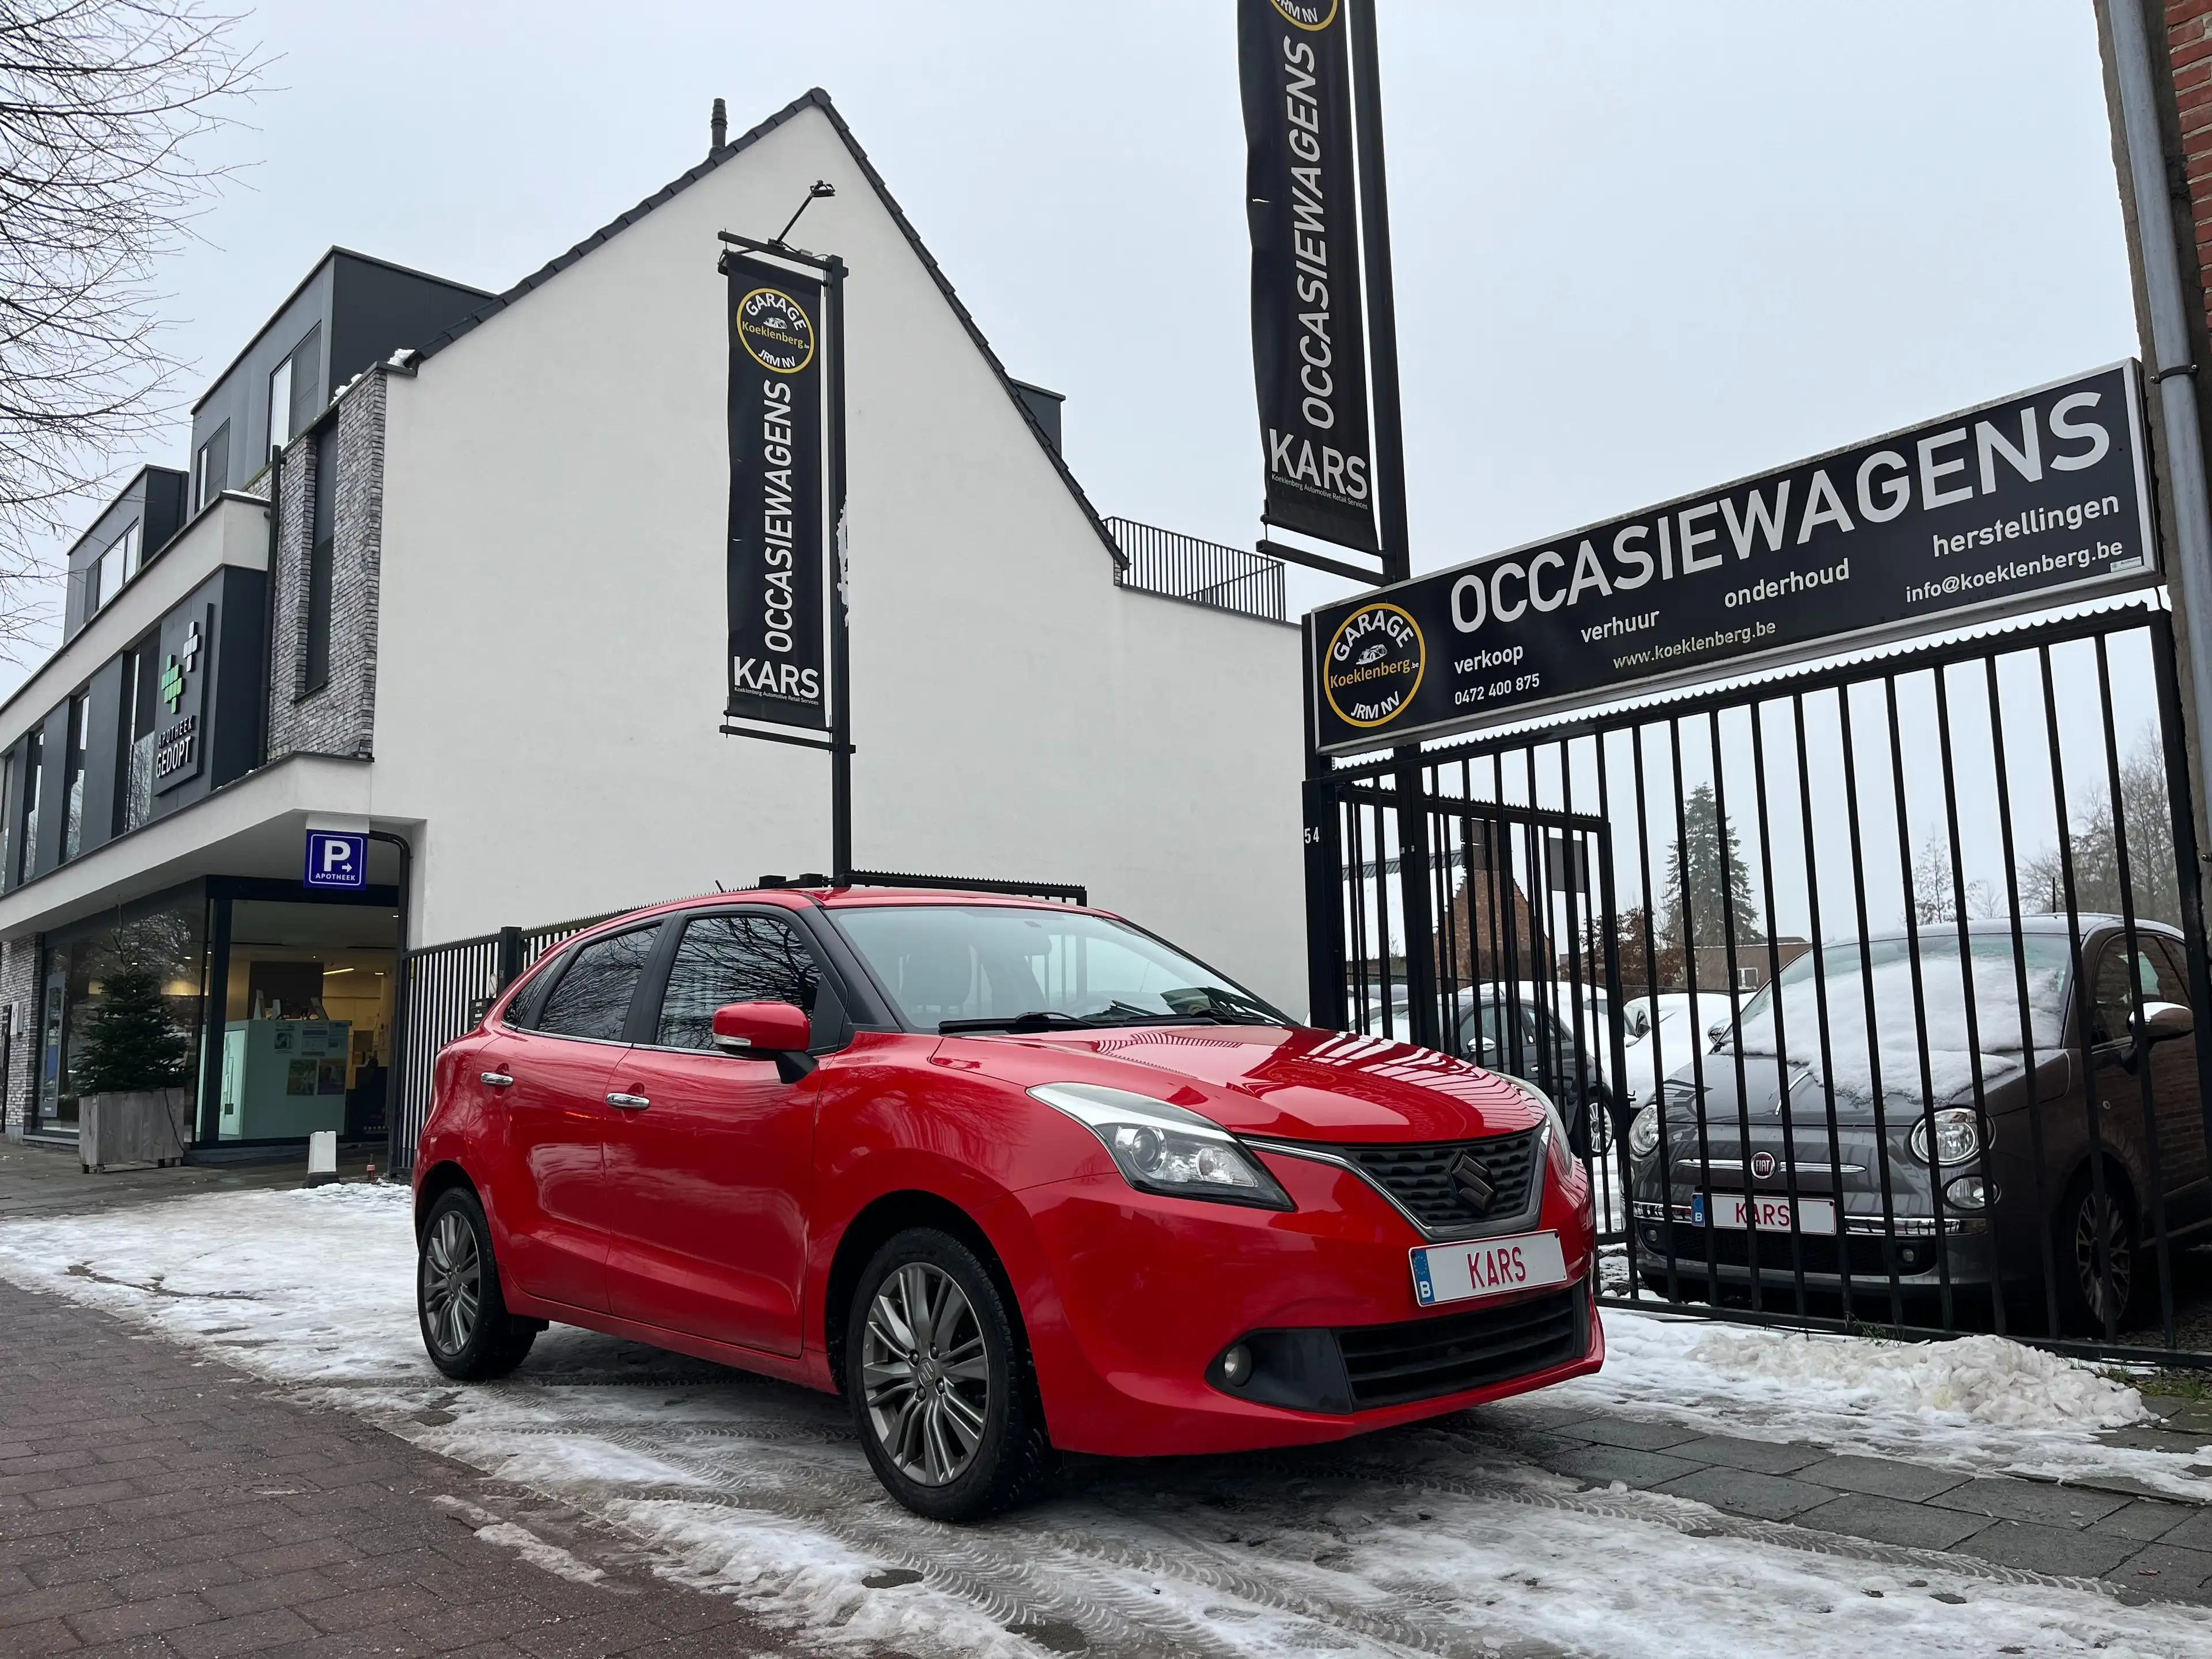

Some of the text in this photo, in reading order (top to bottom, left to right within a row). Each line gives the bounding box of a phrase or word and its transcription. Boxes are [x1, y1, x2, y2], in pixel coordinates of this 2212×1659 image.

[1283, 35, 1334, 429] OCCASIEWAGENS
[746, 293, 806, 330] GARAGE
[758, 350, 796, 368] JRM NV
[1270, 429, 1368, 499] KARS
[1272, 474, 1368, 509] Koeklenberg Automotive Retail Services
[764, 380, 792, 652] OCCASIEWAGENS
[1451, 392, 2108, 632] OCCASIEWAGENS
[1455, 496, 2119, 673] verkoop verhuur onderhoud herstellingen
[1907, 542, 2122, 602] info@koeklenberg.be
[1334, 611, 1412, 661] GARAGE
[1613, 623, 1775, 668] www.koeklenberg.be
[734, 656, 819, 698] KARS
[763, 691, 787, 700] Automotive
[1455, 673, 1539, 704] 0472 400 875
[1351, 691, 1400, 720] JRM NV
[158, 715, 192, 748] APOTHEEK
[156, 736, 191, 778] GEDOPT
[1304, 827, 1319, 845] 54
[324, 840, 350, 872] P
[1755, 1159, 1770, 1172] FIAT
[1695, 1203, 1790, 1226] B KARS
[1419, 1246, 1526, 1298] B KARS
